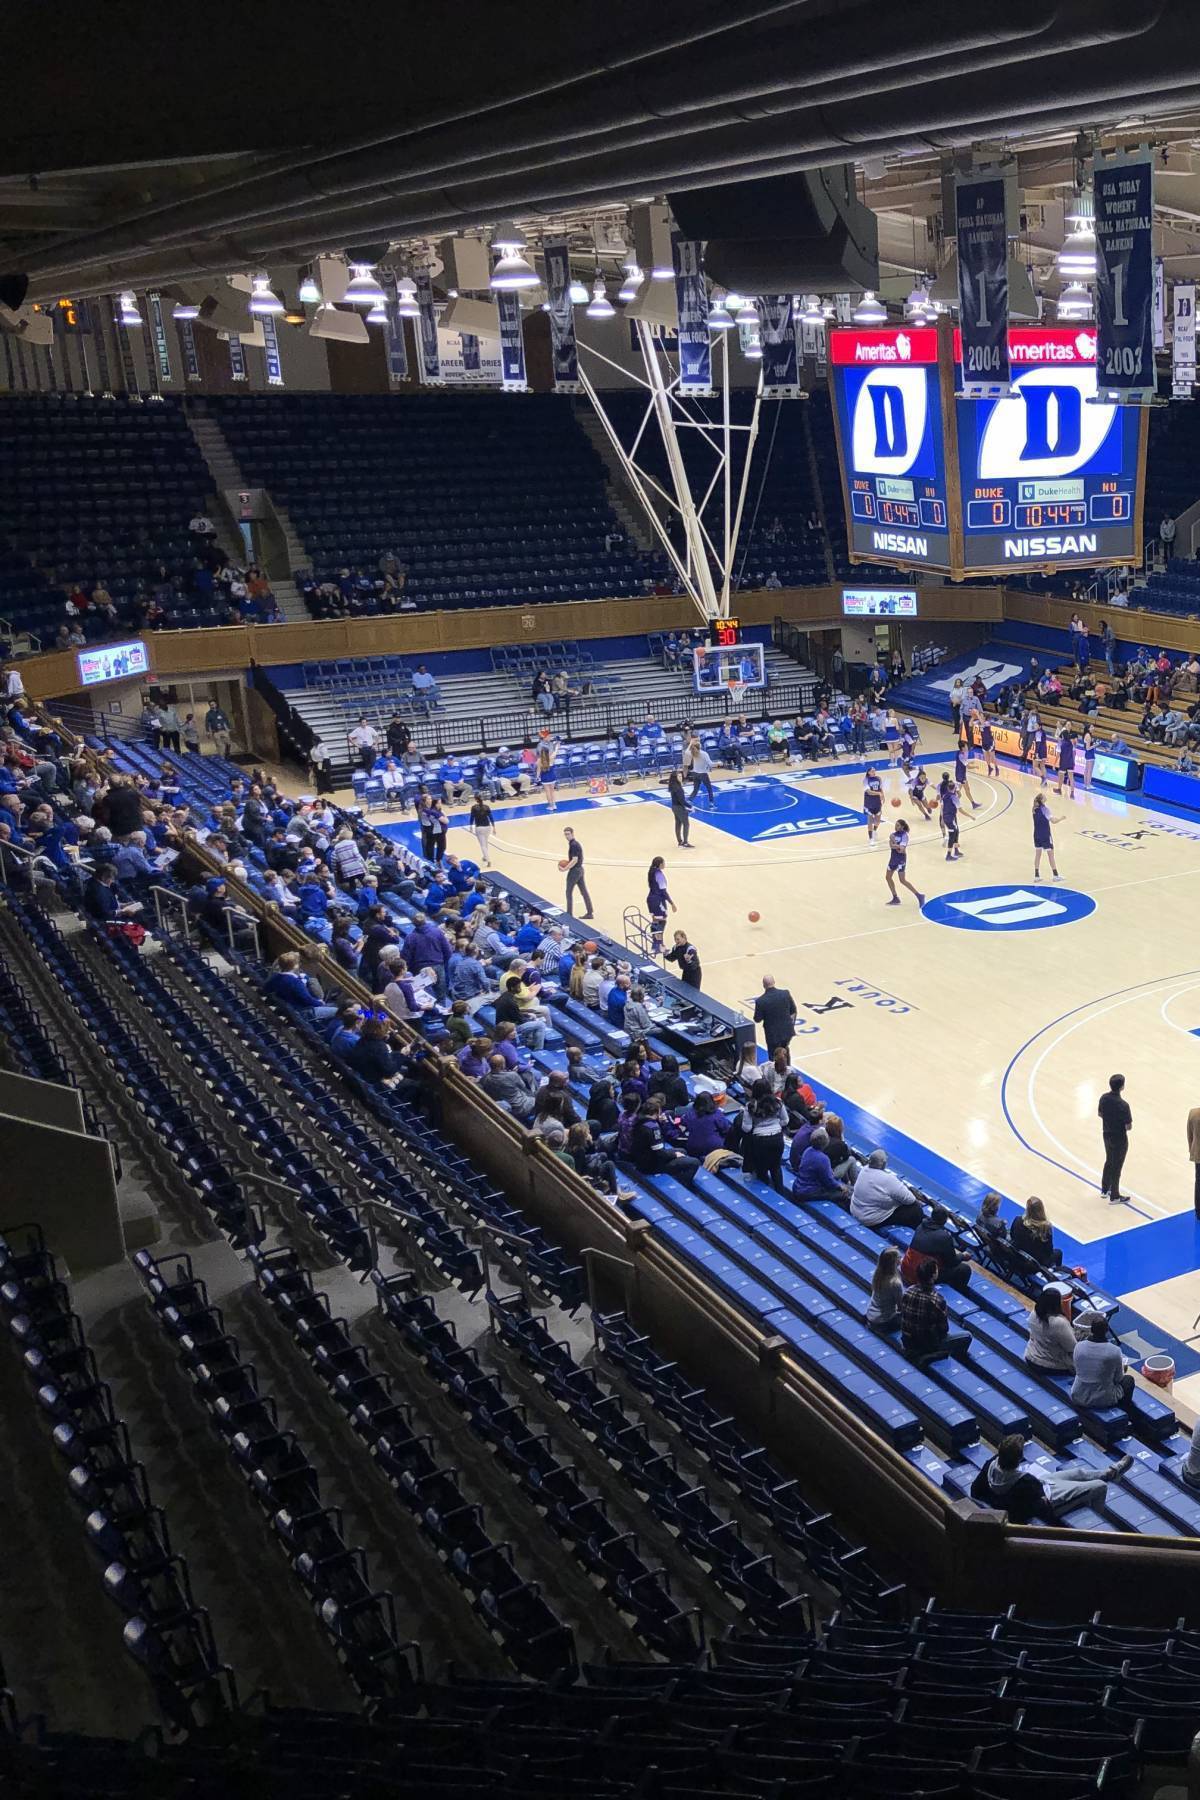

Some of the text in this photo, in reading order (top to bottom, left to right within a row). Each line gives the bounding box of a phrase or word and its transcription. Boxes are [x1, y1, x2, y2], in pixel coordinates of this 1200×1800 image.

[975, 271, 992, 327] 1
[1110, 263, 1129, 326] 1
[855, 342, 897, 361] Ameritas
[968, 345, 1000, 371] 2004
[1105, 346, 1143, 376] 2003
[975, 488, 1004, 499] DUKE
[1038, 487, 1082, 496] DukeHealth
[864, 496, 873, 515] 0
[933, 503, 942, 524] 0
[992, 502, 1004, 525] 0
[1112, 496, 1123, 517] 0
[873, 532, 928, 556] NISSAN
[1004, 534, 1097, 557] NISSAN
[718, 629, 737, 646] 30
[752, 813, 861, 839] ACC
[1121, 829, 1161, 840] K
[1081, 829, 1148, 851] COURT
[801, 996, 856, 1015] K
[833, 979, 911, 1014] COURT
